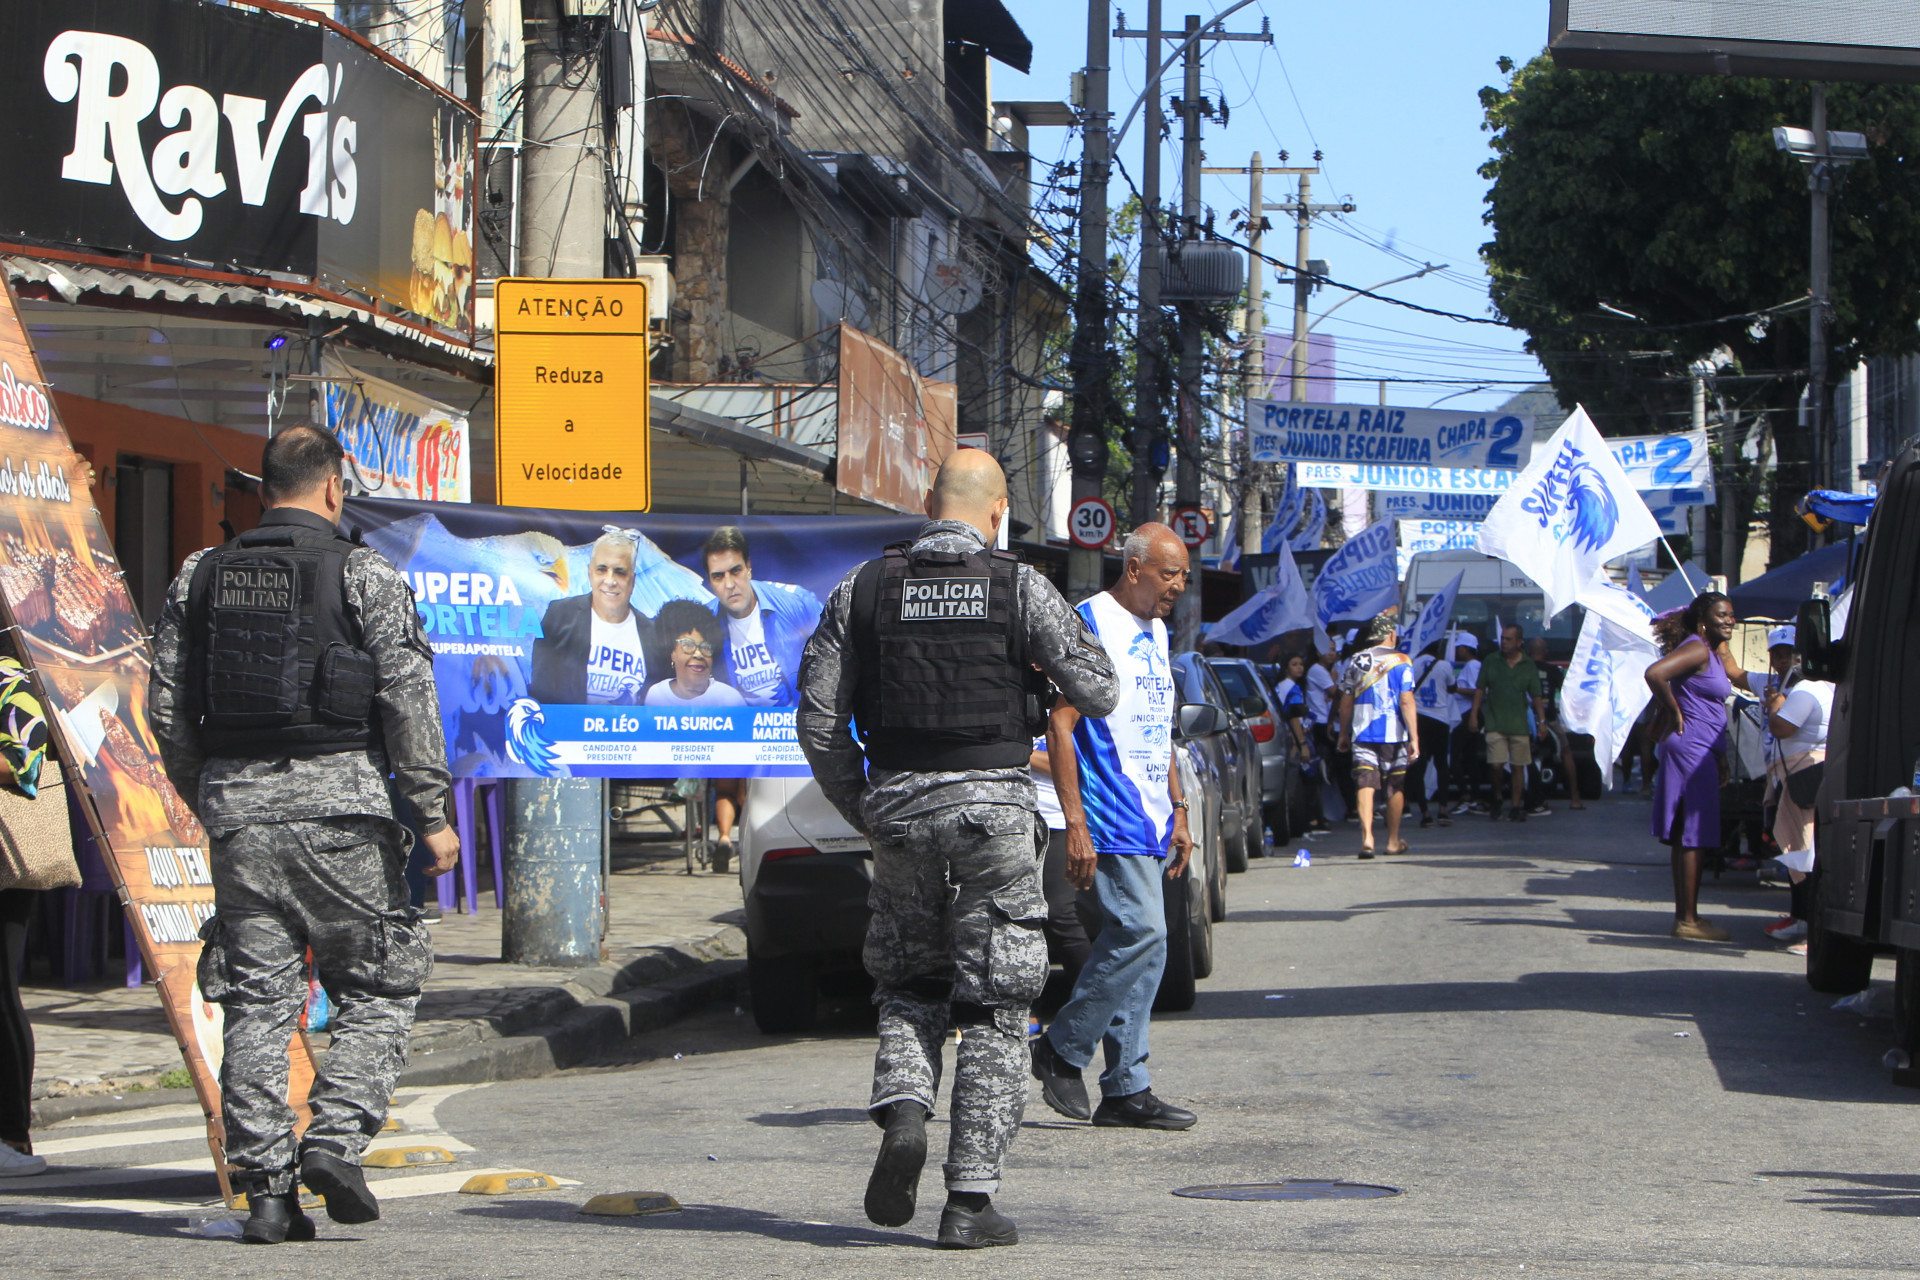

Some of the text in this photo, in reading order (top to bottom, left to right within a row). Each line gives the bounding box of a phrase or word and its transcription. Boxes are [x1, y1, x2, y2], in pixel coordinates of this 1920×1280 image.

[44, 30, 357, 242] Ravi's
[518, 296, 623, 321] ATENÇÃO
[536, 366, 604, 384] Reduza
[564, 419, 574, 433] a
[1265, 405, 1406, 434] PORTELA RAIZ
[1279, 430, 1342, 458] JUNIOR
[1345, 433, 1431, 462] ESCAFURA
[1437, 416, 1523, 469] CHAPA 2
[1651, 437, 1692, 486] 2
[522, 463, 622, 481] Velocidade
[1306, 465, 1345, 480] PRES.
[1350, 465, 1442, 488] JUNIOR
[1386, 496, 1420, 509] PRES.
[1078, 508, 1106, 528] 30
[1079, 529, 1104, 539] km/h
[223, 569, 289, 589] POLÍCIA
[401, 571, 522, 606] UPERA
[221, 590, 288, 608] MILITAR
[905, 580, 984, 601] POLÍCIA
[904, 601, 985, 618] MILITAR
[416, 603, 544, 638] ORTELA
[588, 645, 645, 679] UPERA
[583, 714, 640, 733] DR. LÉO
[654, 715, 734, 731] TIA SURICA
[583, 744, 628, 752] CANDIDATO
[587, 753, 632, 761] PRESIDENTE
[144, 847, 213, 890] AQUI TEM
[141, 904, 201, 943] COMIDA
